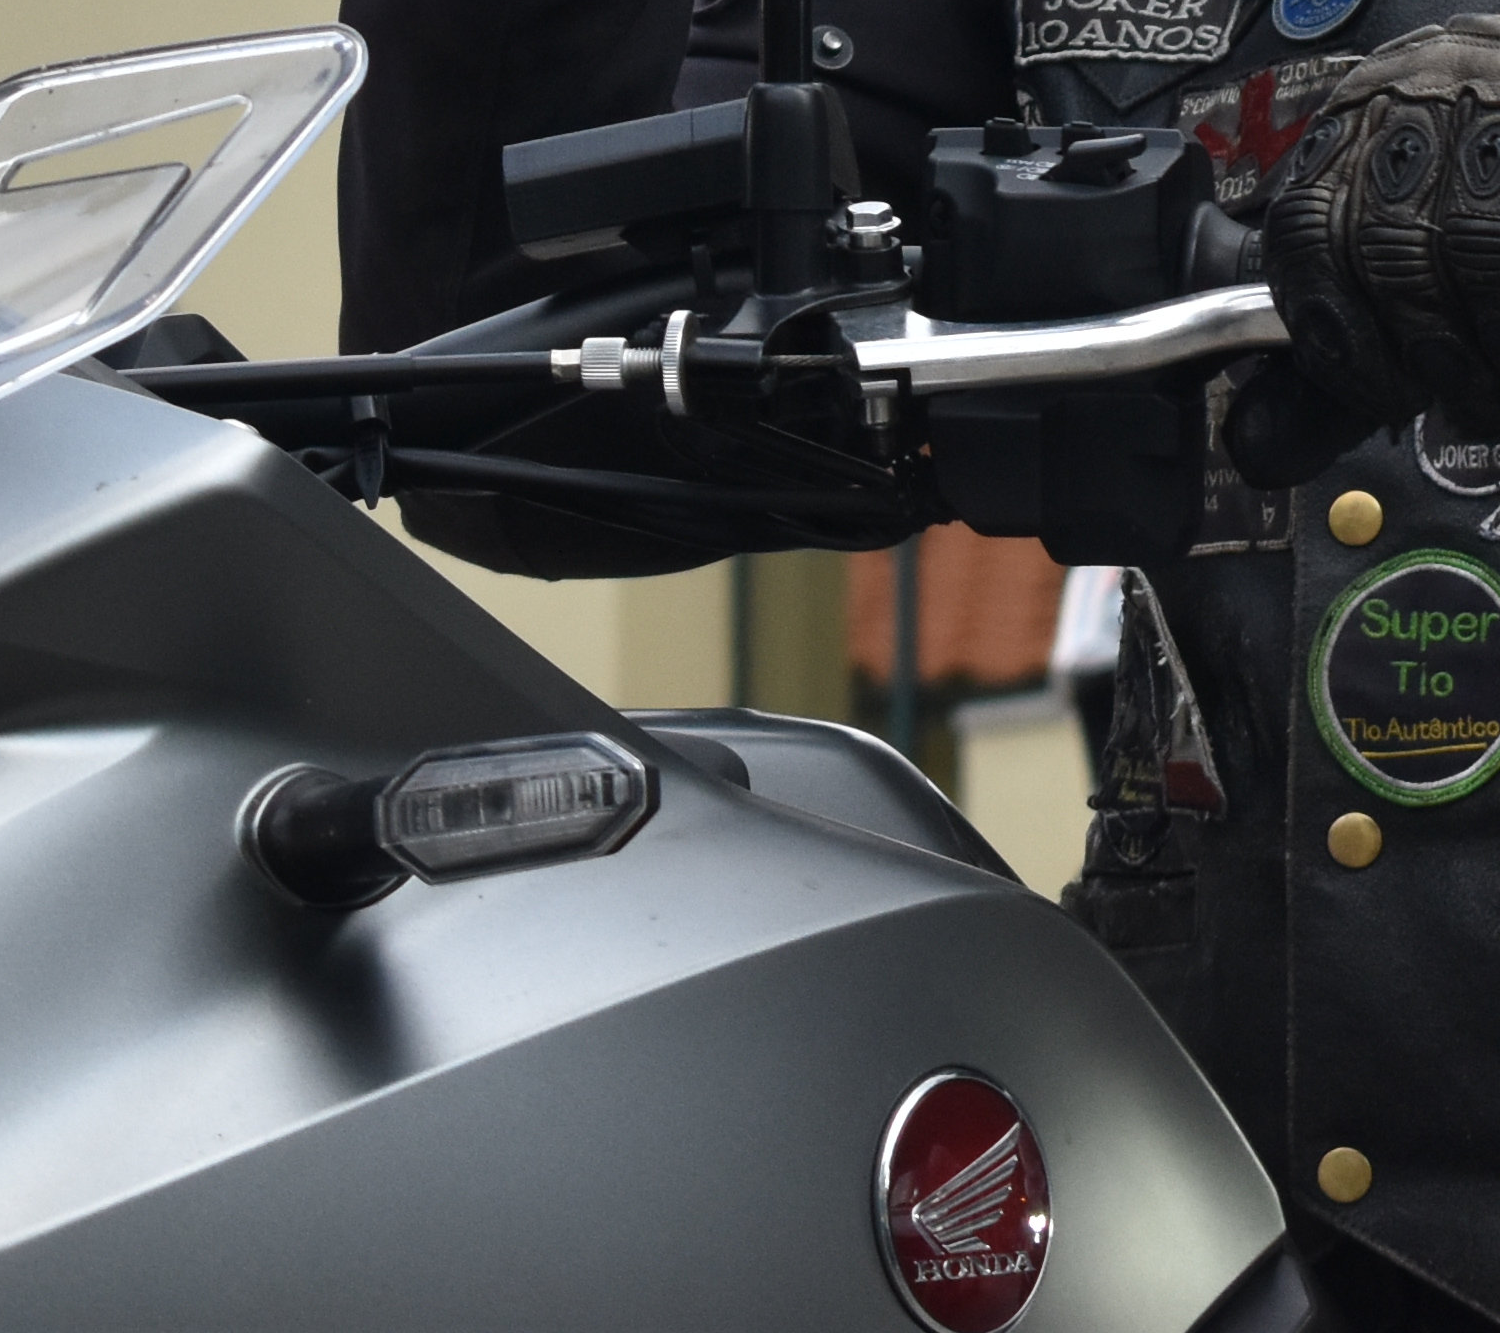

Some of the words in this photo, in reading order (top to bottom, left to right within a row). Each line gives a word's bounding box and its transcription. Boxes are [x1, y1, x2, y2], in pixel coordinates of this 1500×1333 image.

[1024, 18, 1069, 53] 10
[1069, 19, 1223, 51] ANOS
[1214, 169, 1258, 202] 015
[1433, 443, 1489, 469] JOKER
[1359, 597, 1500, 653] Super
[1388, 659, 1455, 699] Tio
[1341, 716, 1382, 743] Tio
[912, 1250, 1037, 1283] HONDA
